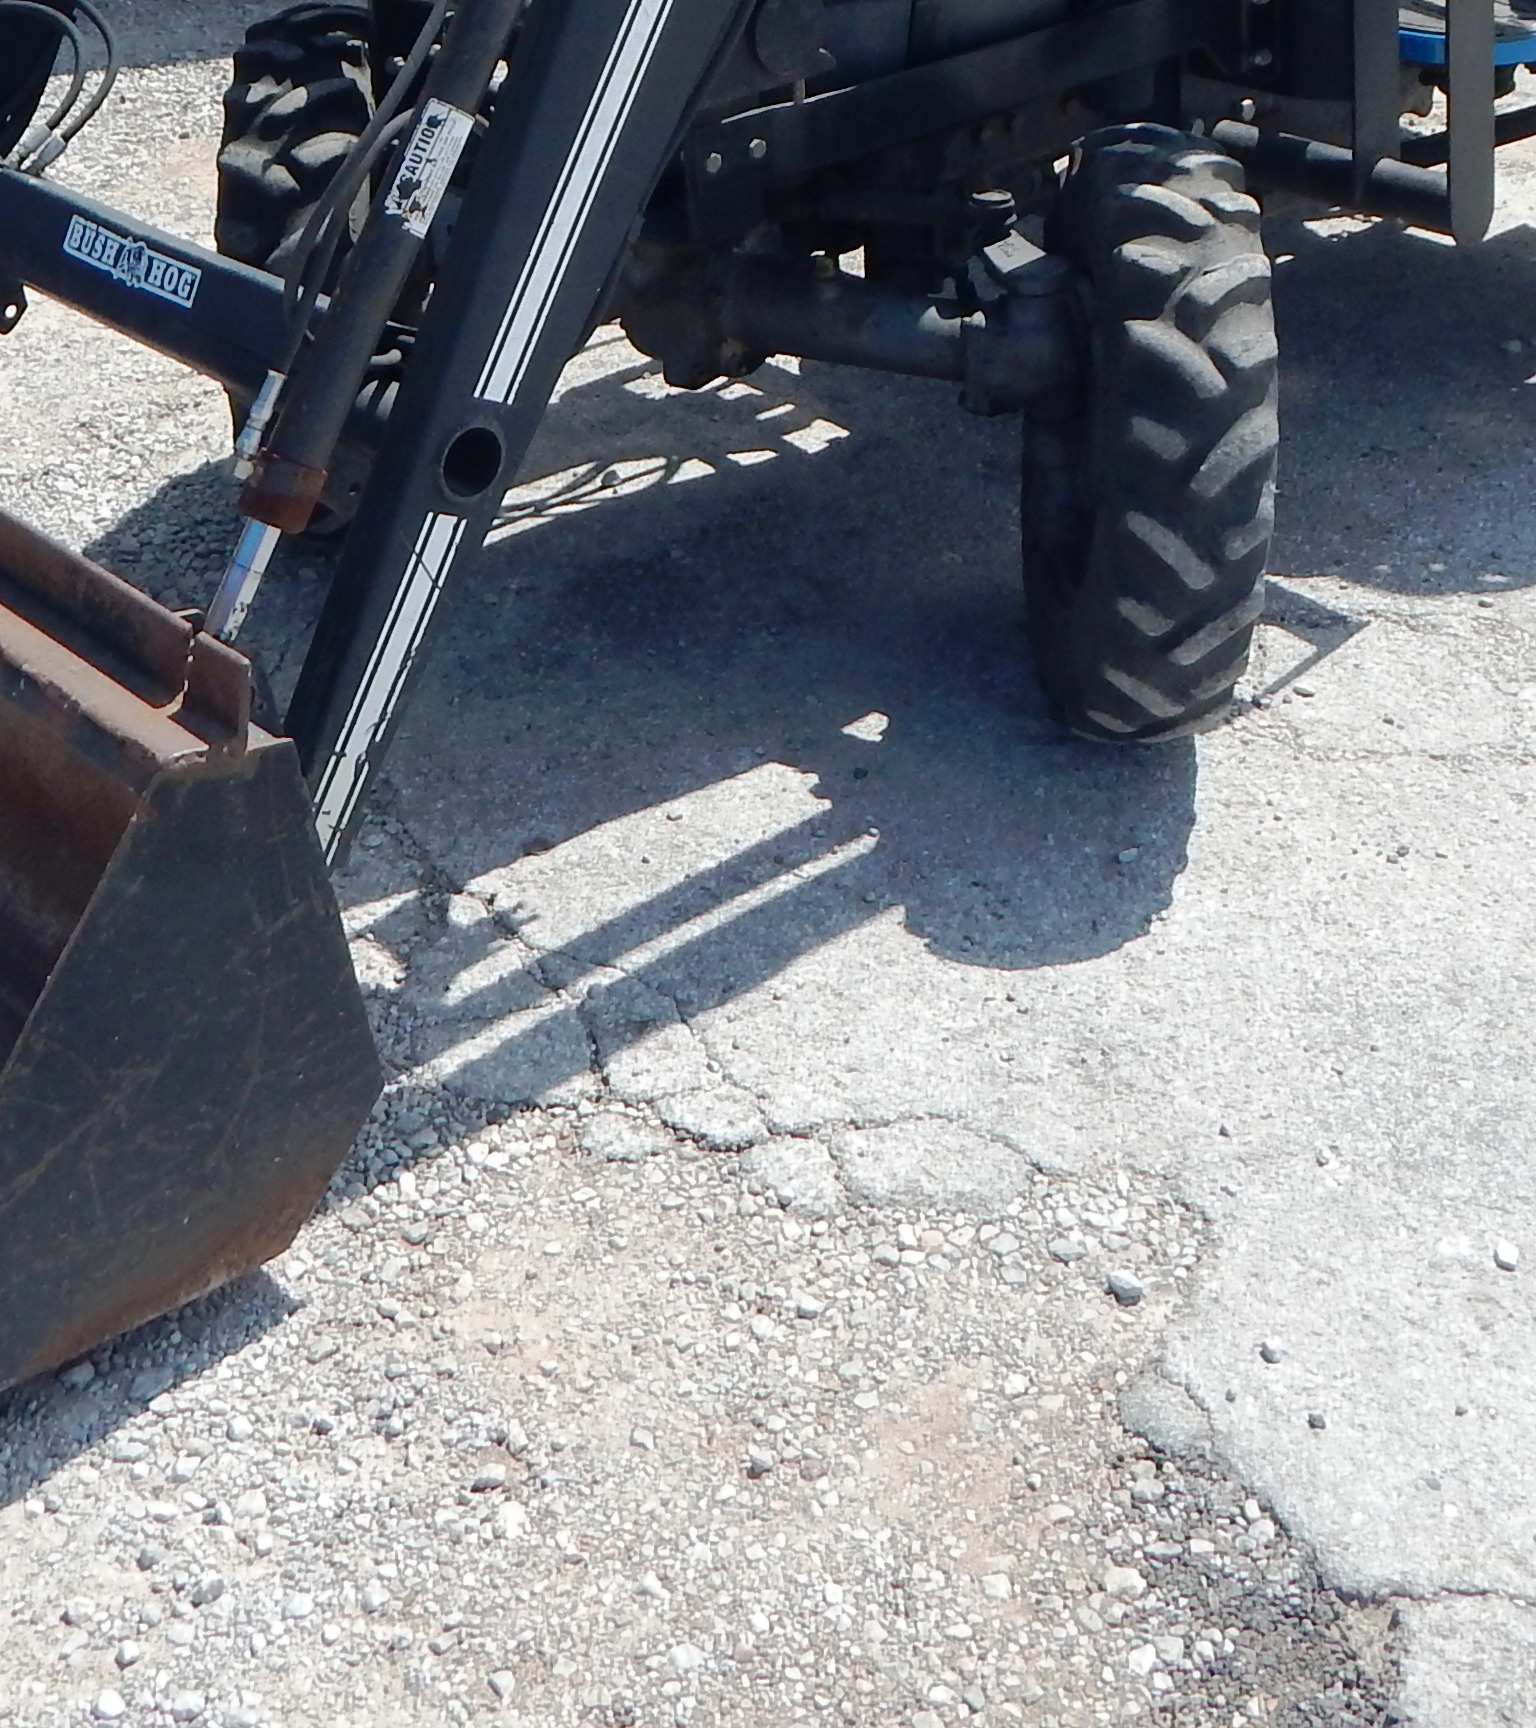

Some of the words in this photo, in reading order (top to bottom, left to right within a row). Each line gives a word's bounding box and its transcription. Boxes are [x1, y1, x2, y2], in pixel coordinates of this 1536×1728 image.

[398, 113, 445, 185] CAUTIO
[69, 224, 121, 267] BUSH
[147, 258, 193, 299] HOG
